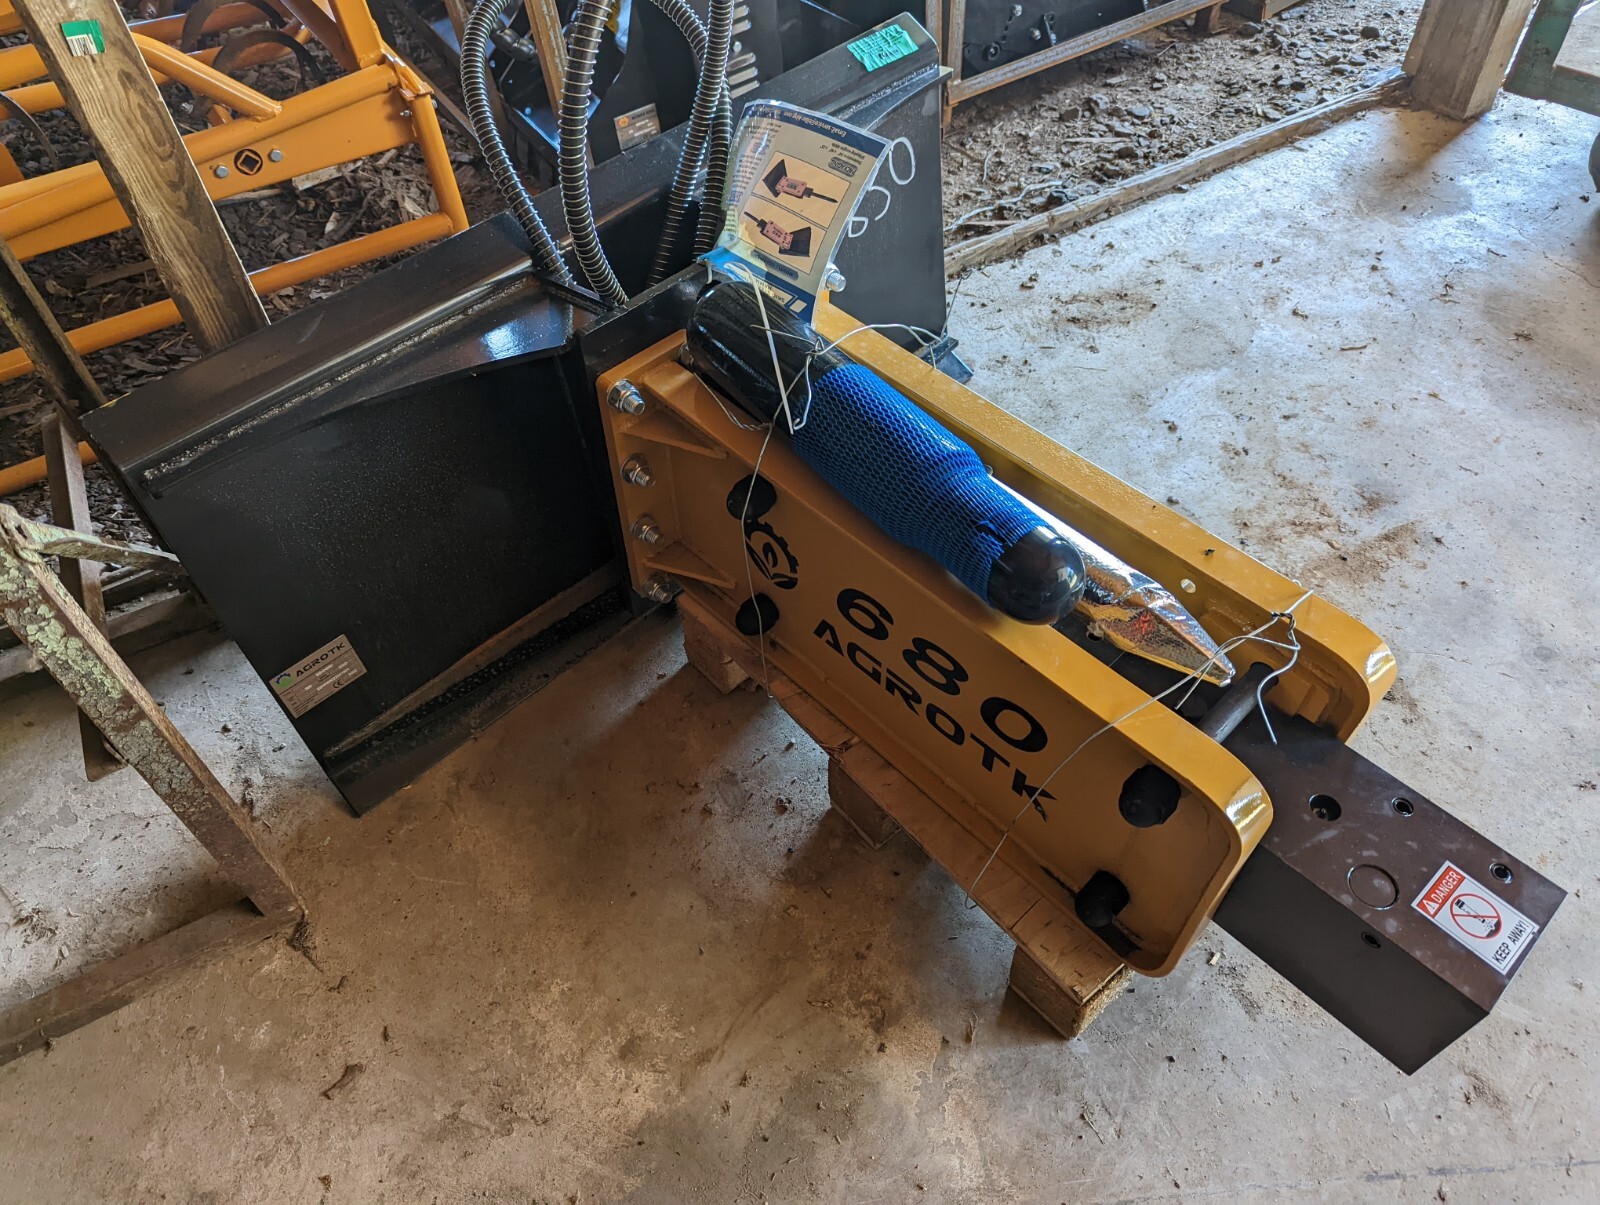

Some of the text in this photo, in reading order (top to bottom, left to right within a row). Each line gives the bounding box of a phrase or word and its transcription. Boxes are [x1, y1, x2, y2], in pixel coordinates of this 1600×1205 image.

[296, 642, 345, 677] AGROTK
[837, 588, 1048, 752] 680
[813, 619, 1058, 822] AGROTK
[1431, 870, 1461, 904] DANGER
[1492, 919, 1530, 965] KEEP AWAY!
